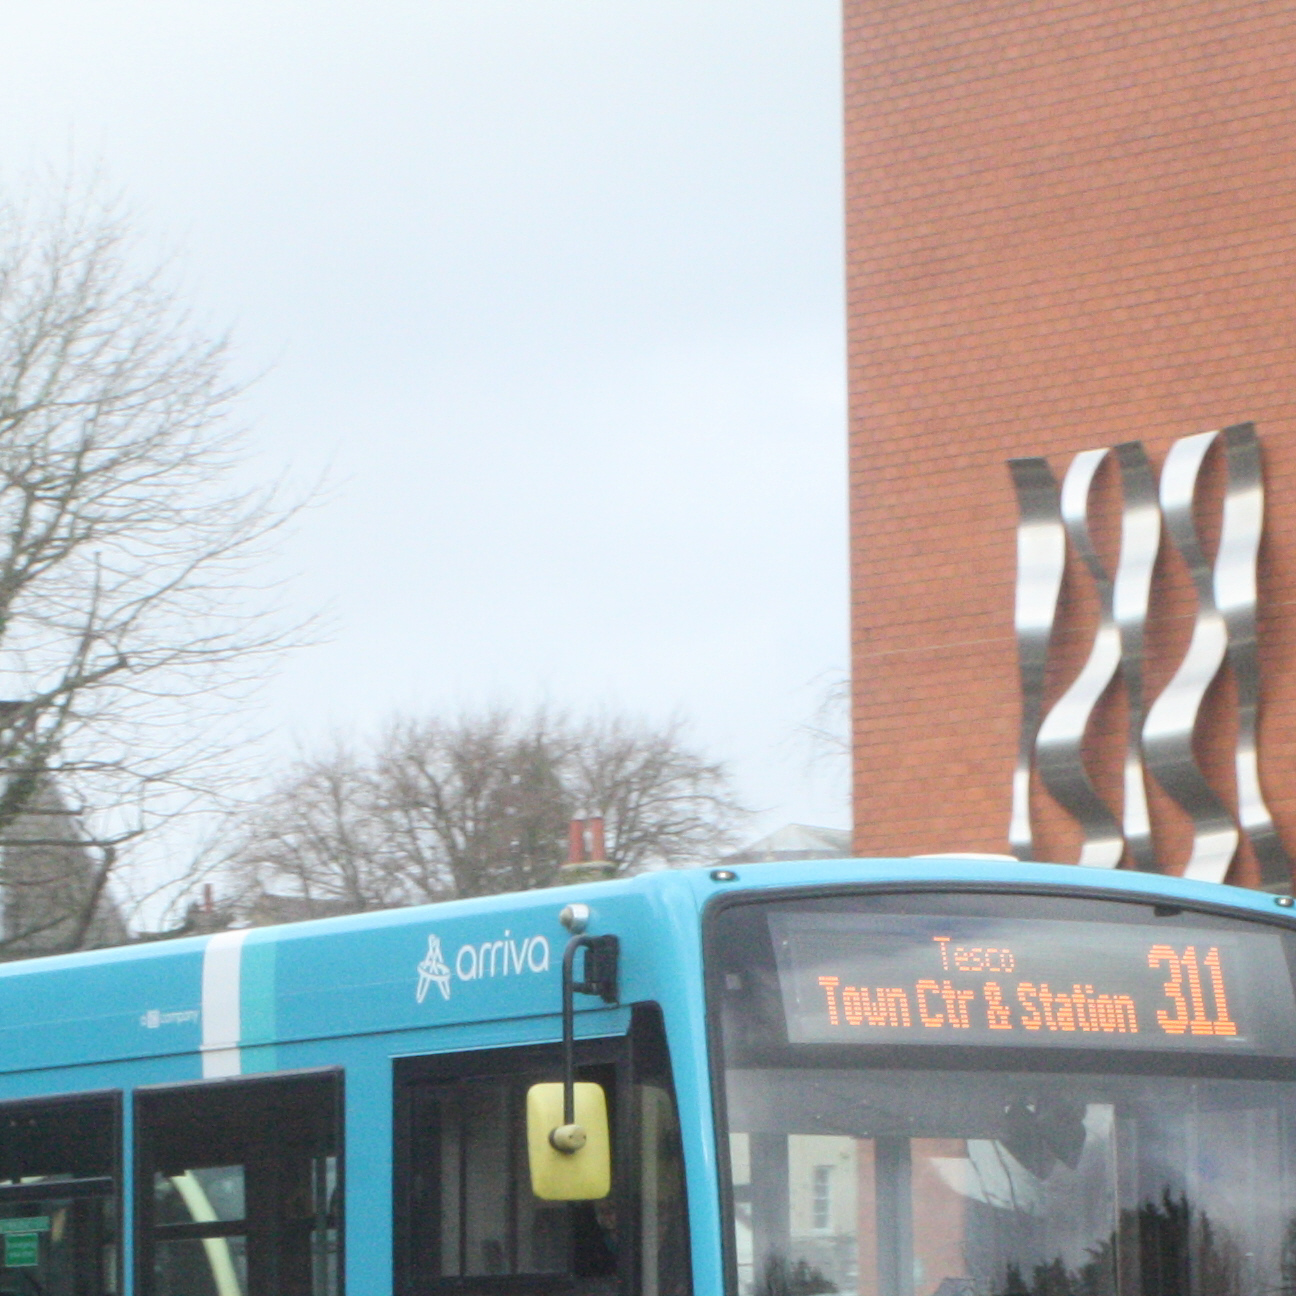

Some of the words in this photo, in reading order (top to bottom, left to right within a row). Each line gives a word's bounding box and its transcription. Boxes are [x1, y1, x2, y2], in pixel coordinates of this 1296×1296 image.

[456, 929, 550, 982] arriva
[933, 936, 1015, 973] Tesco
[818, 976, 911, 1027] Town
[916, 979, 975, 1029] Ctr
[983, 982, 1013, 1030] &
[1017, 982, 1138, 1034] Station
[1147, 944, 1238, 1036] 311
